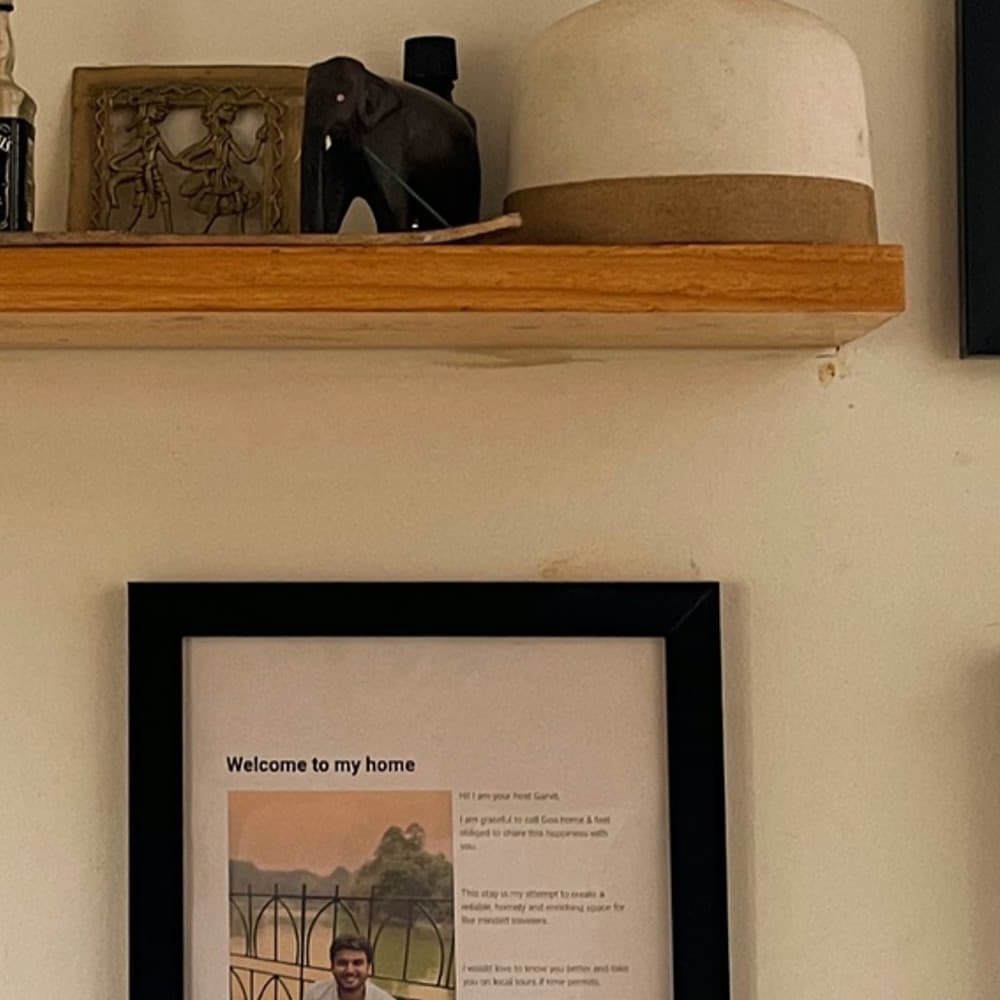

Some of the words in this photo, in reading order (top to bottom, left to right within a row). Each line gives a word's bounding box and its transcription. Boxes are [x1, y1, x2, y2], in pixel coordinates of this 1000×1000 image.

[226, 756, 307, 772] Welcome
[312, 757, 329, 772] to
[335, 759, 361, 776] my
[366, 755, 415, 772] home
